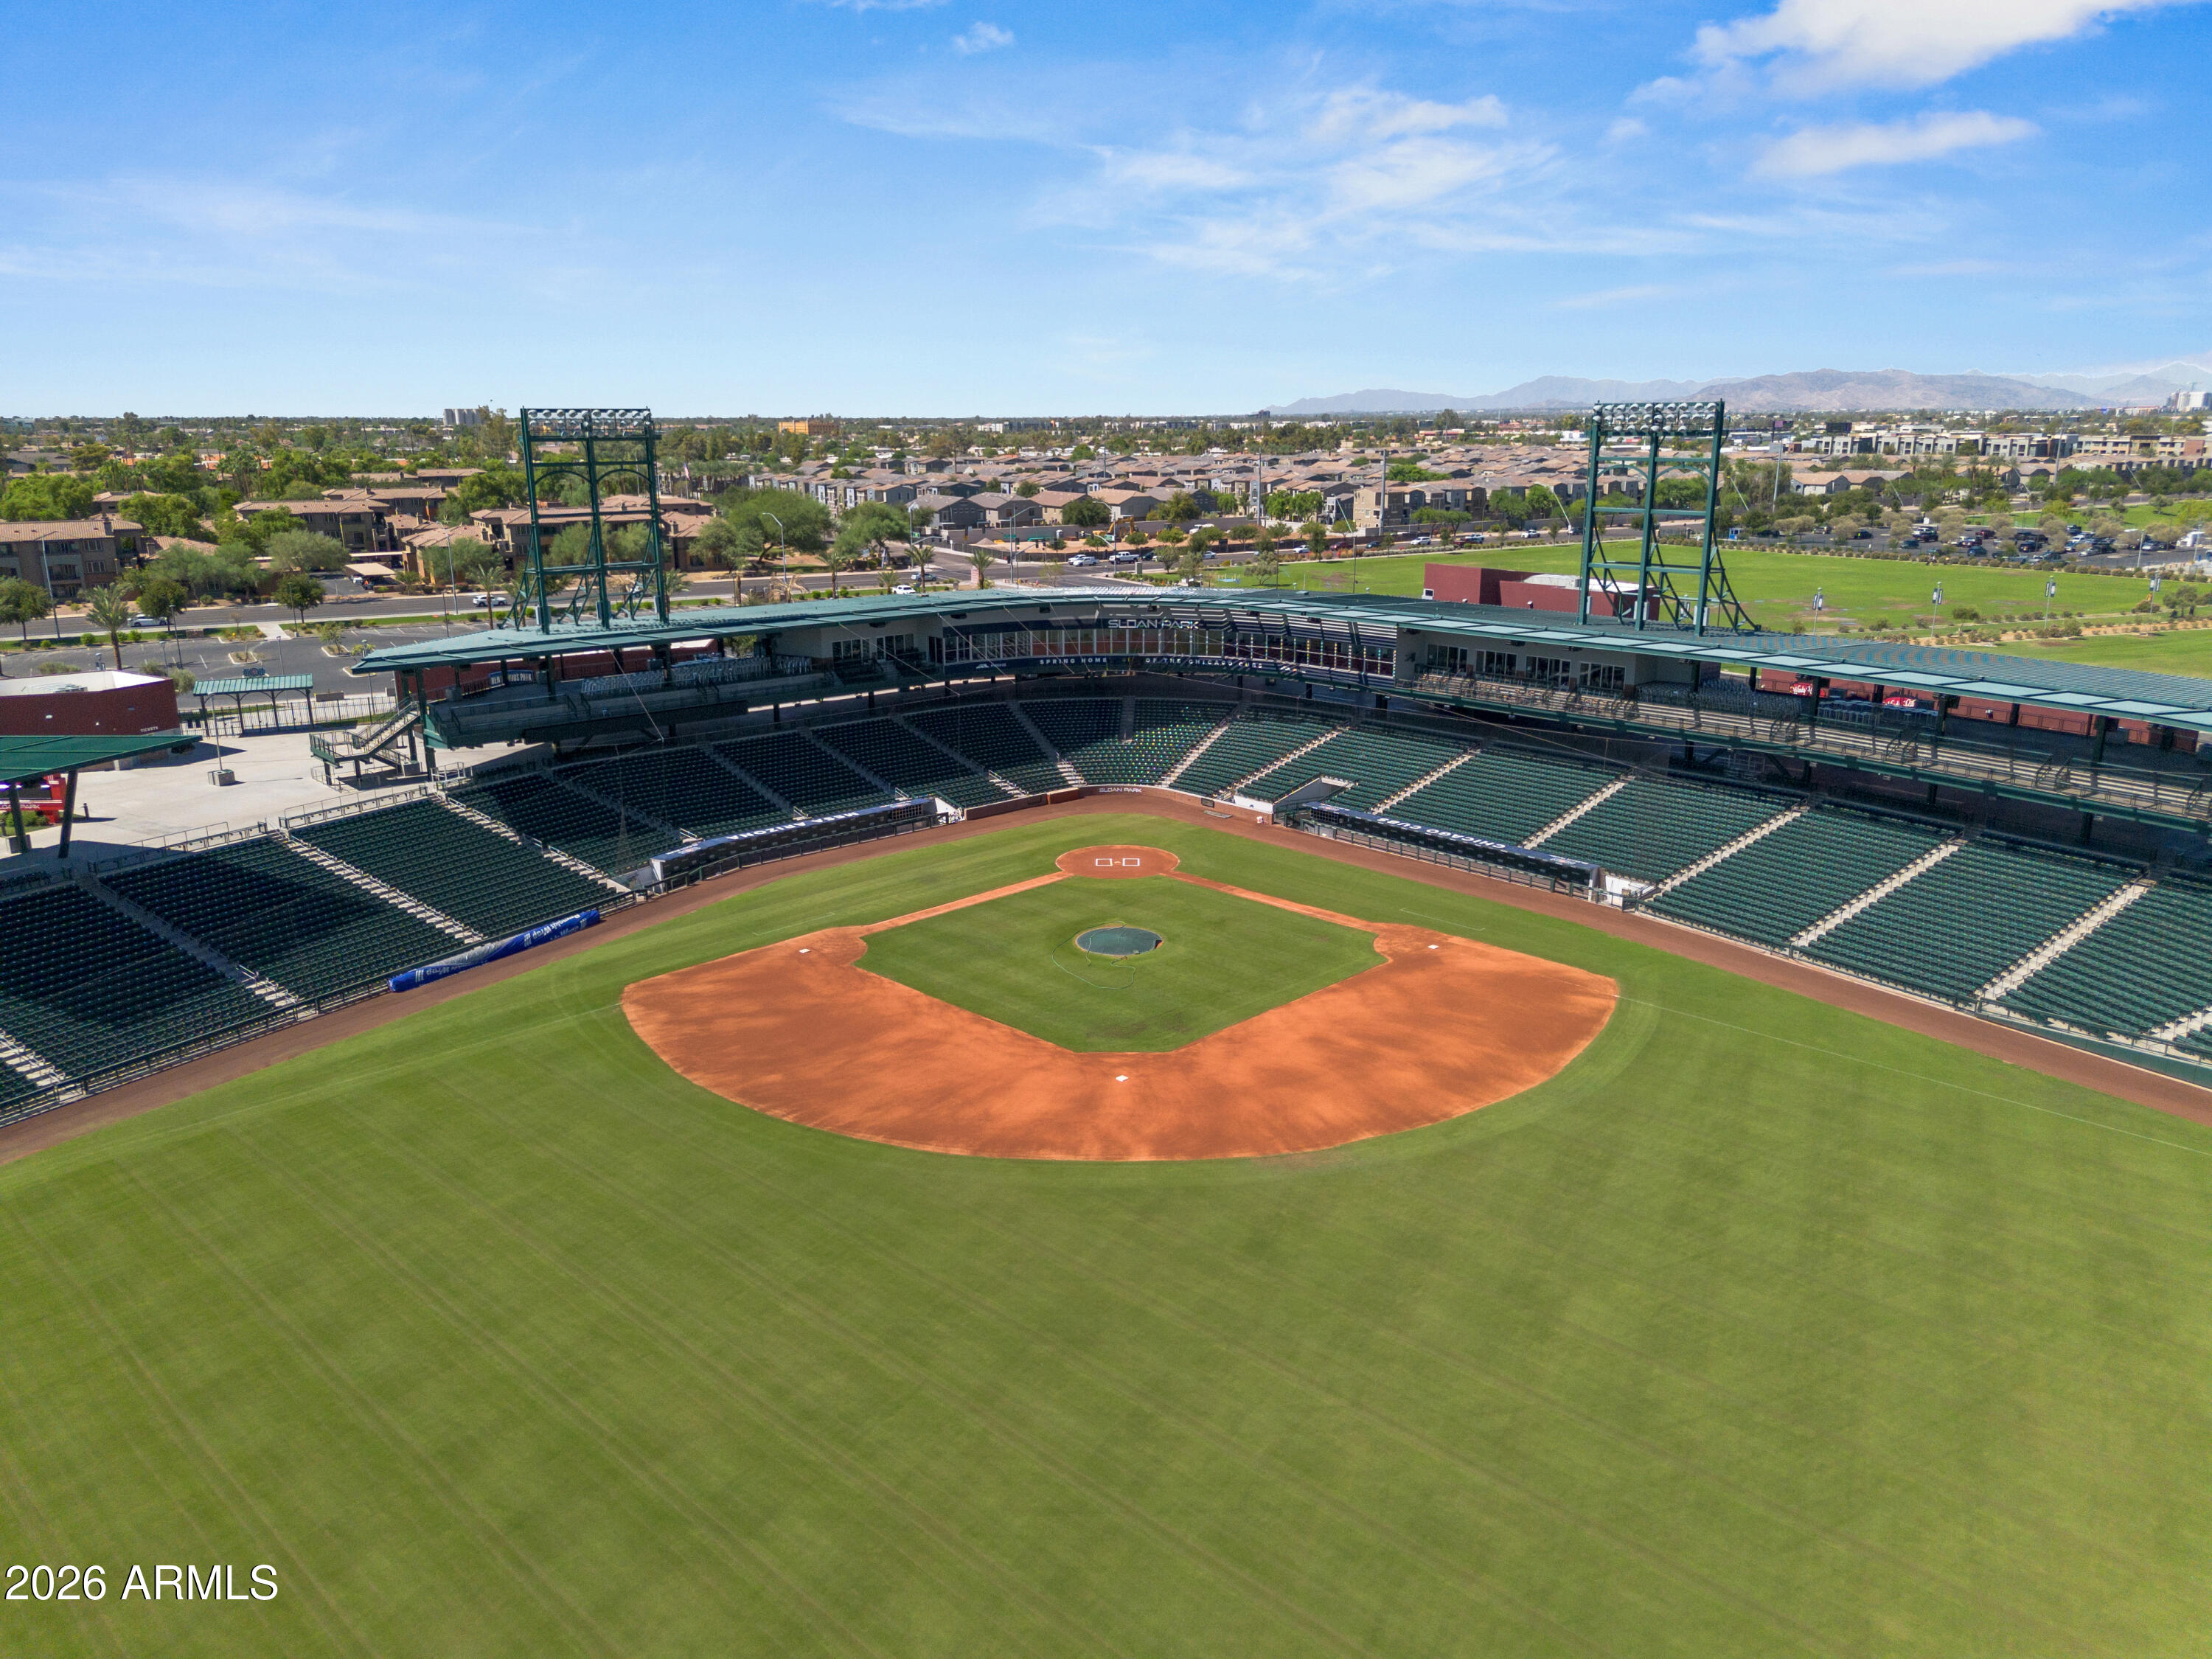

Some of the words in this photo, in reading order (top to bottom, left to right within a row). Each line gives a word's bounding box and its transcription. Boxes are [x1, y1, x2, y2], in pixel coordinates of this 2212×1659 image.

[1107, 619, 1158, 629] SLOAN
[1161, 619, 1199, 629] PARK
[1188, 658, 1233, 667] CHICAGO
[1377, 818, 1422, 830] CUBS
[726, 822, 806, 840] ARIZONA
[1426, 829, 1506, 849] CHICAGO
